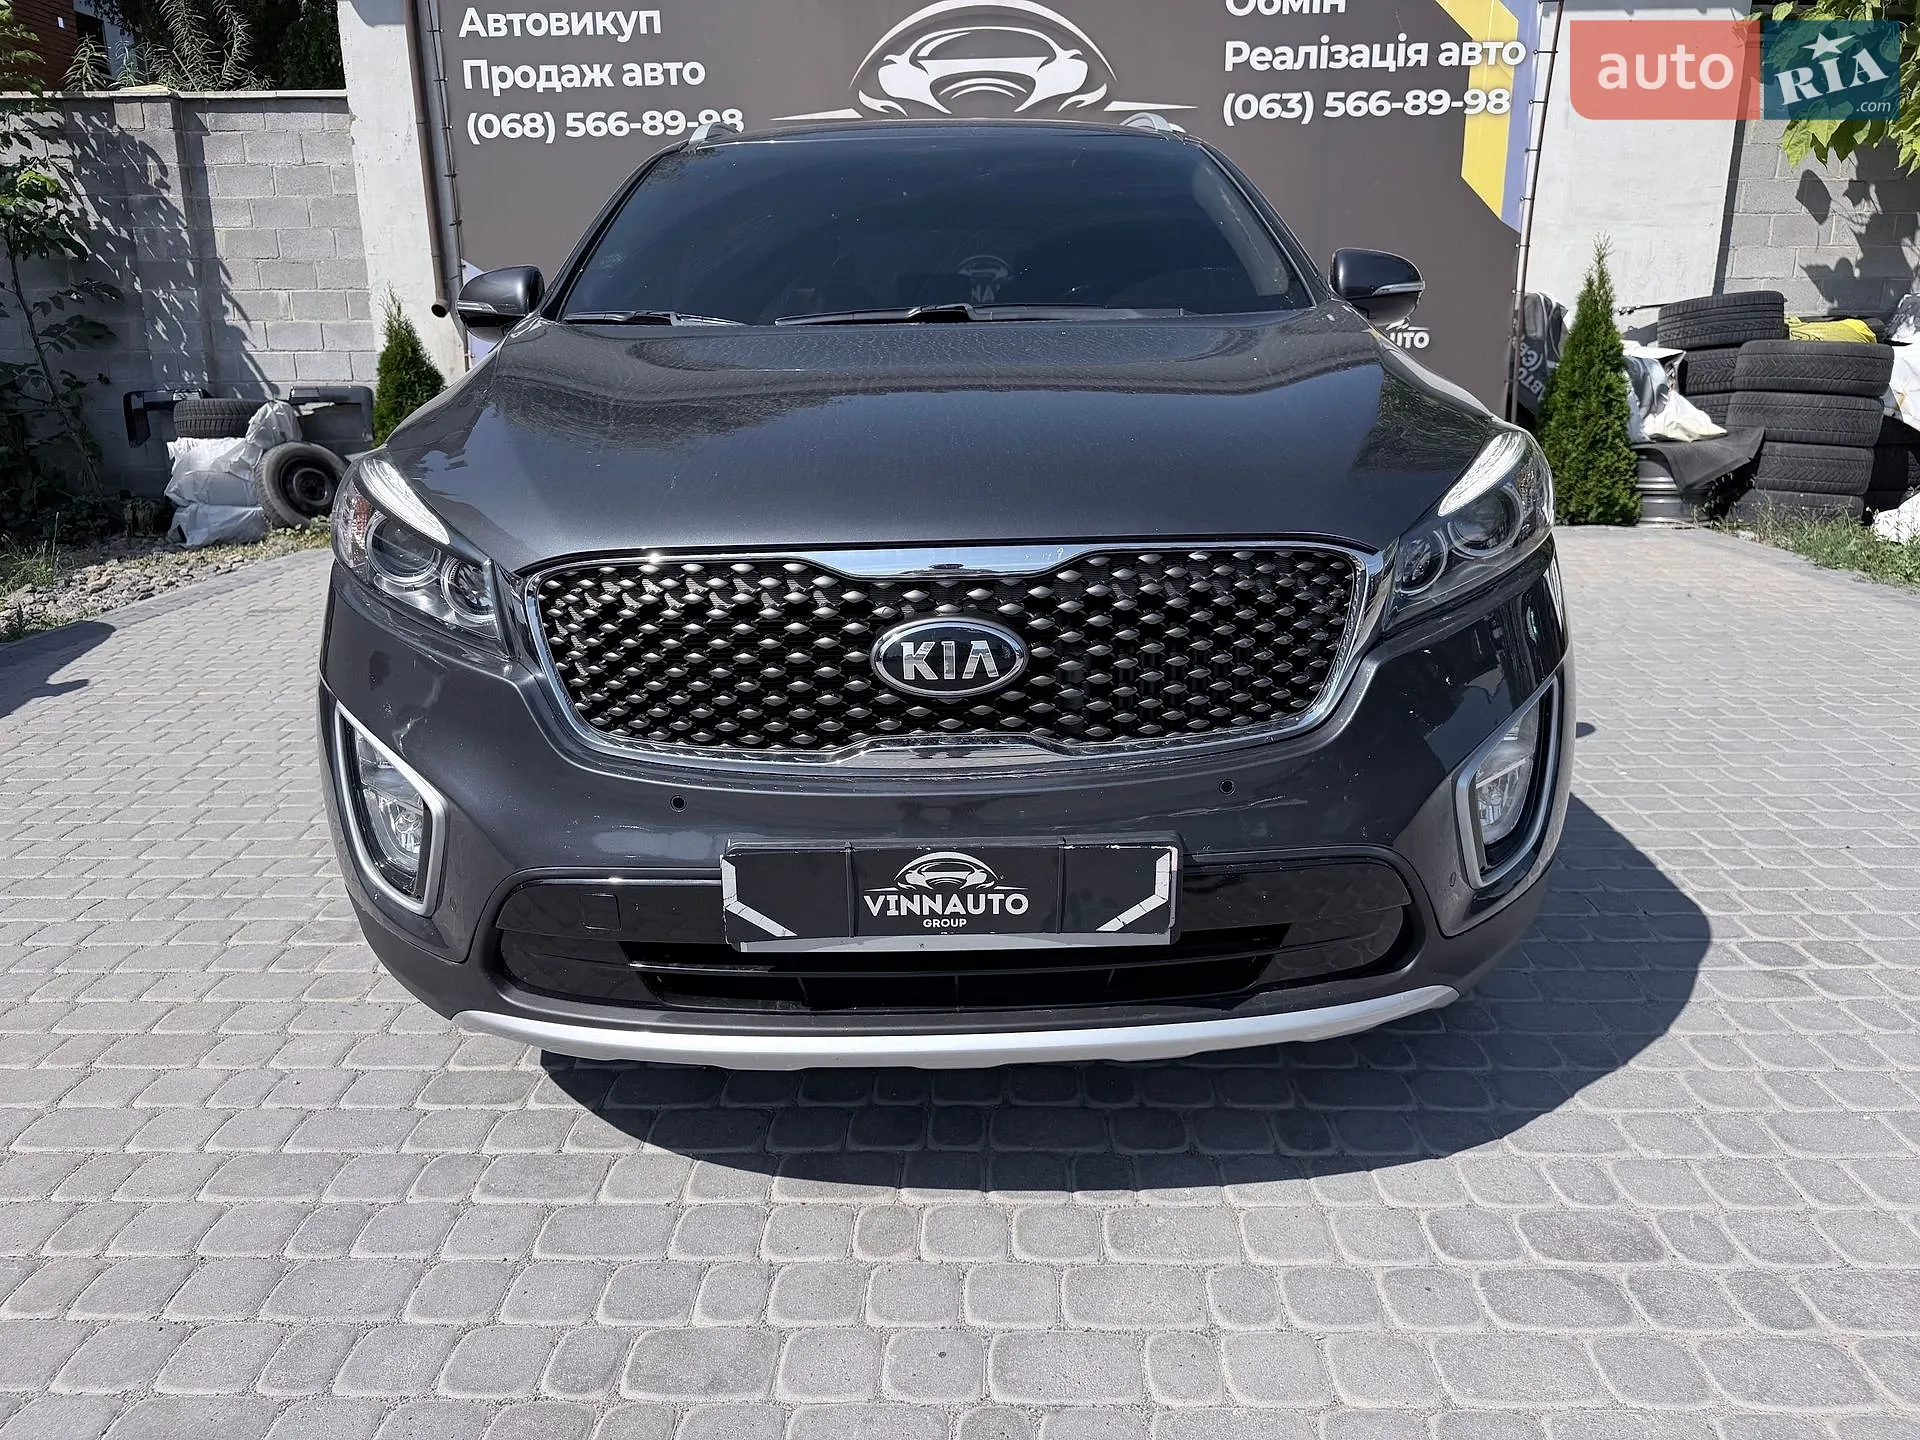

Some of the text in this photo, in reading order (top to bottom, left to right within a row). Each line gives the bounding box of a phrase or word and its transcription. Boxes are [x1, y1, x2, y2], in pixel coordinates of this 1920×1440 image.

[458, 7, 662, 43] Автовикуп
[1224, 32, 1527, 73] Реалізація авто
[462, 59, 706, 97] Продаж авто
[1223, 88, 1512, 127] (063) 566-89-98
[466, 108, 745, 145] (068) 566-89-98
[901, 640, 1000, 680] KIA
[863, 893, 1029, 918] VINNAUTO
[922, 917, 967, 929] GROUP
